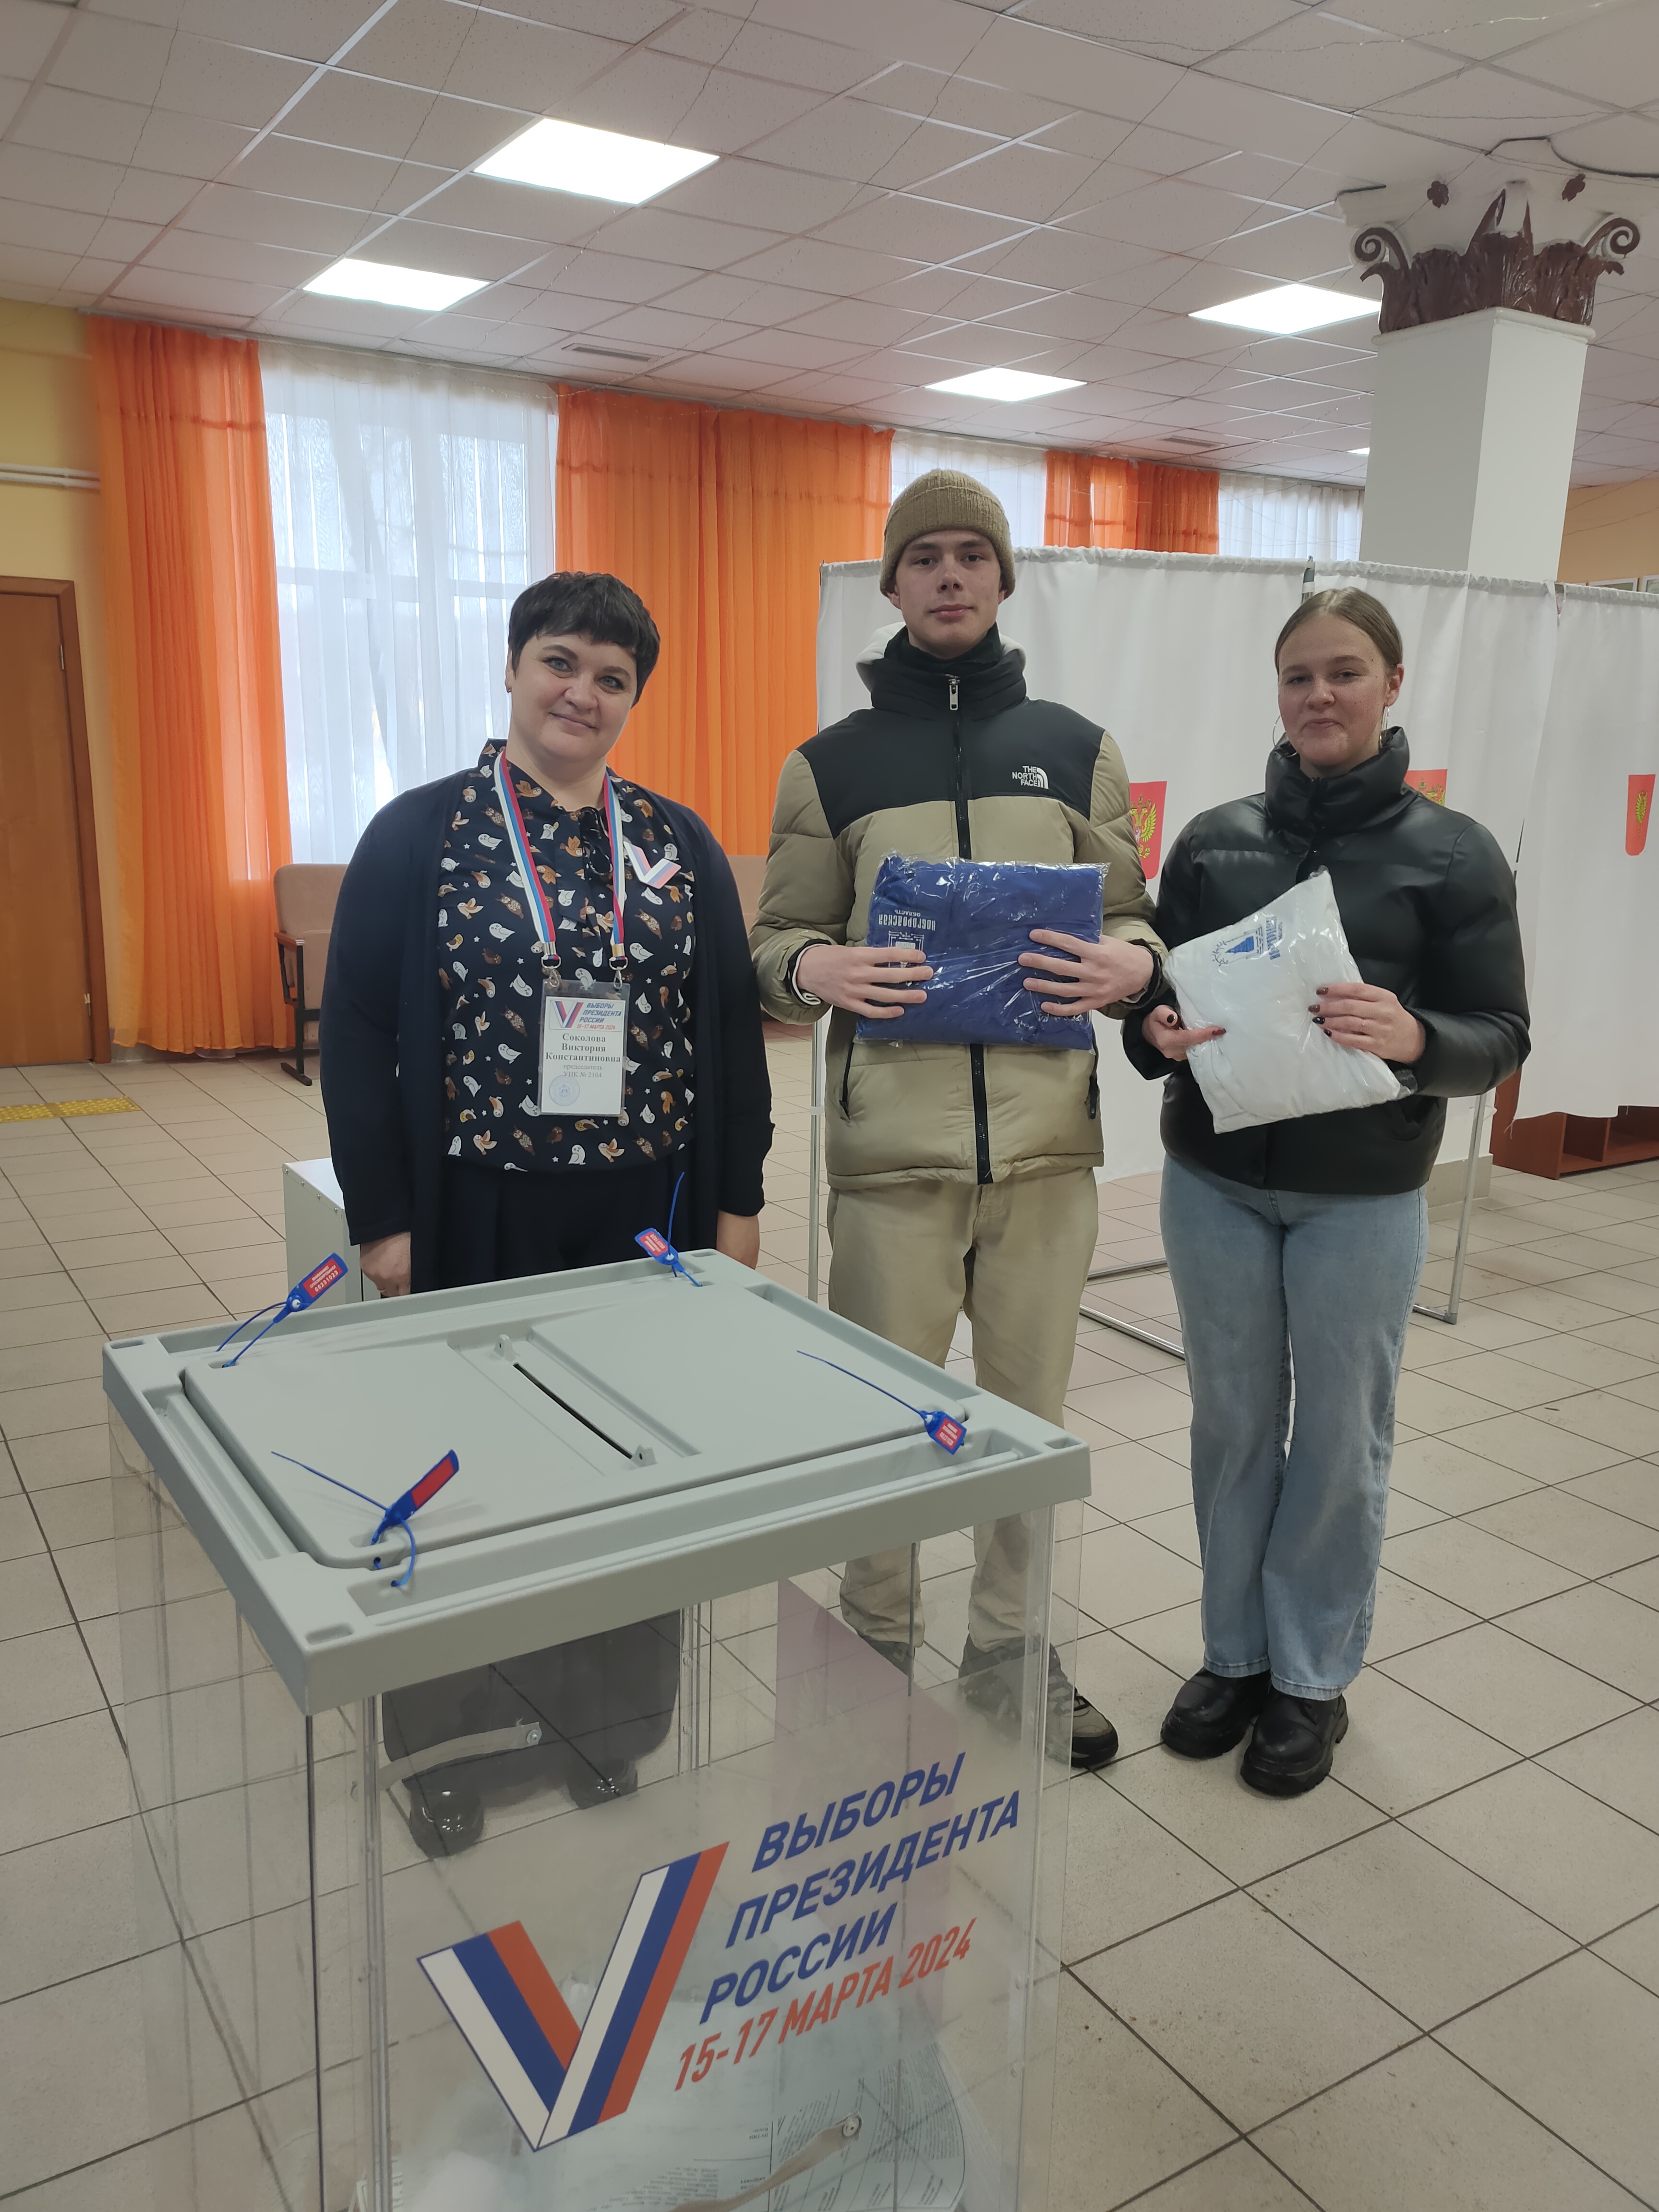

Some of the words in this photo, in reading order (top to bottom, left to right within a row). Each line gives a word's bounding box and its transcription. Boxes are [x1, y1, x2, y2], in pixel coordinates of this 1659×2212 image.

[1012, 771, 1037, 780] NORTH
[1021, 779, 1038, 787] FACE
[878, 914, 936, 931] НОВГОРОДСКАЯ
[562, 1033, 606, 1042] Соколова
[562, 1043, 606, 1053] Виктория
[546, 1052, 621, 1062] Константиновна
[752, 1752, 966, 1873] ВЫБОРЫ
[725, 1790, 1020, 1949] ПРЕЗИДЕНТА
[699, 1902, 898, 2025] РОССИИ
[674, 2007, 779, 2092] 15-17
[778, 1955, 894, 2044] МАРТА
[898, 1917, 977, 1989] 2024
